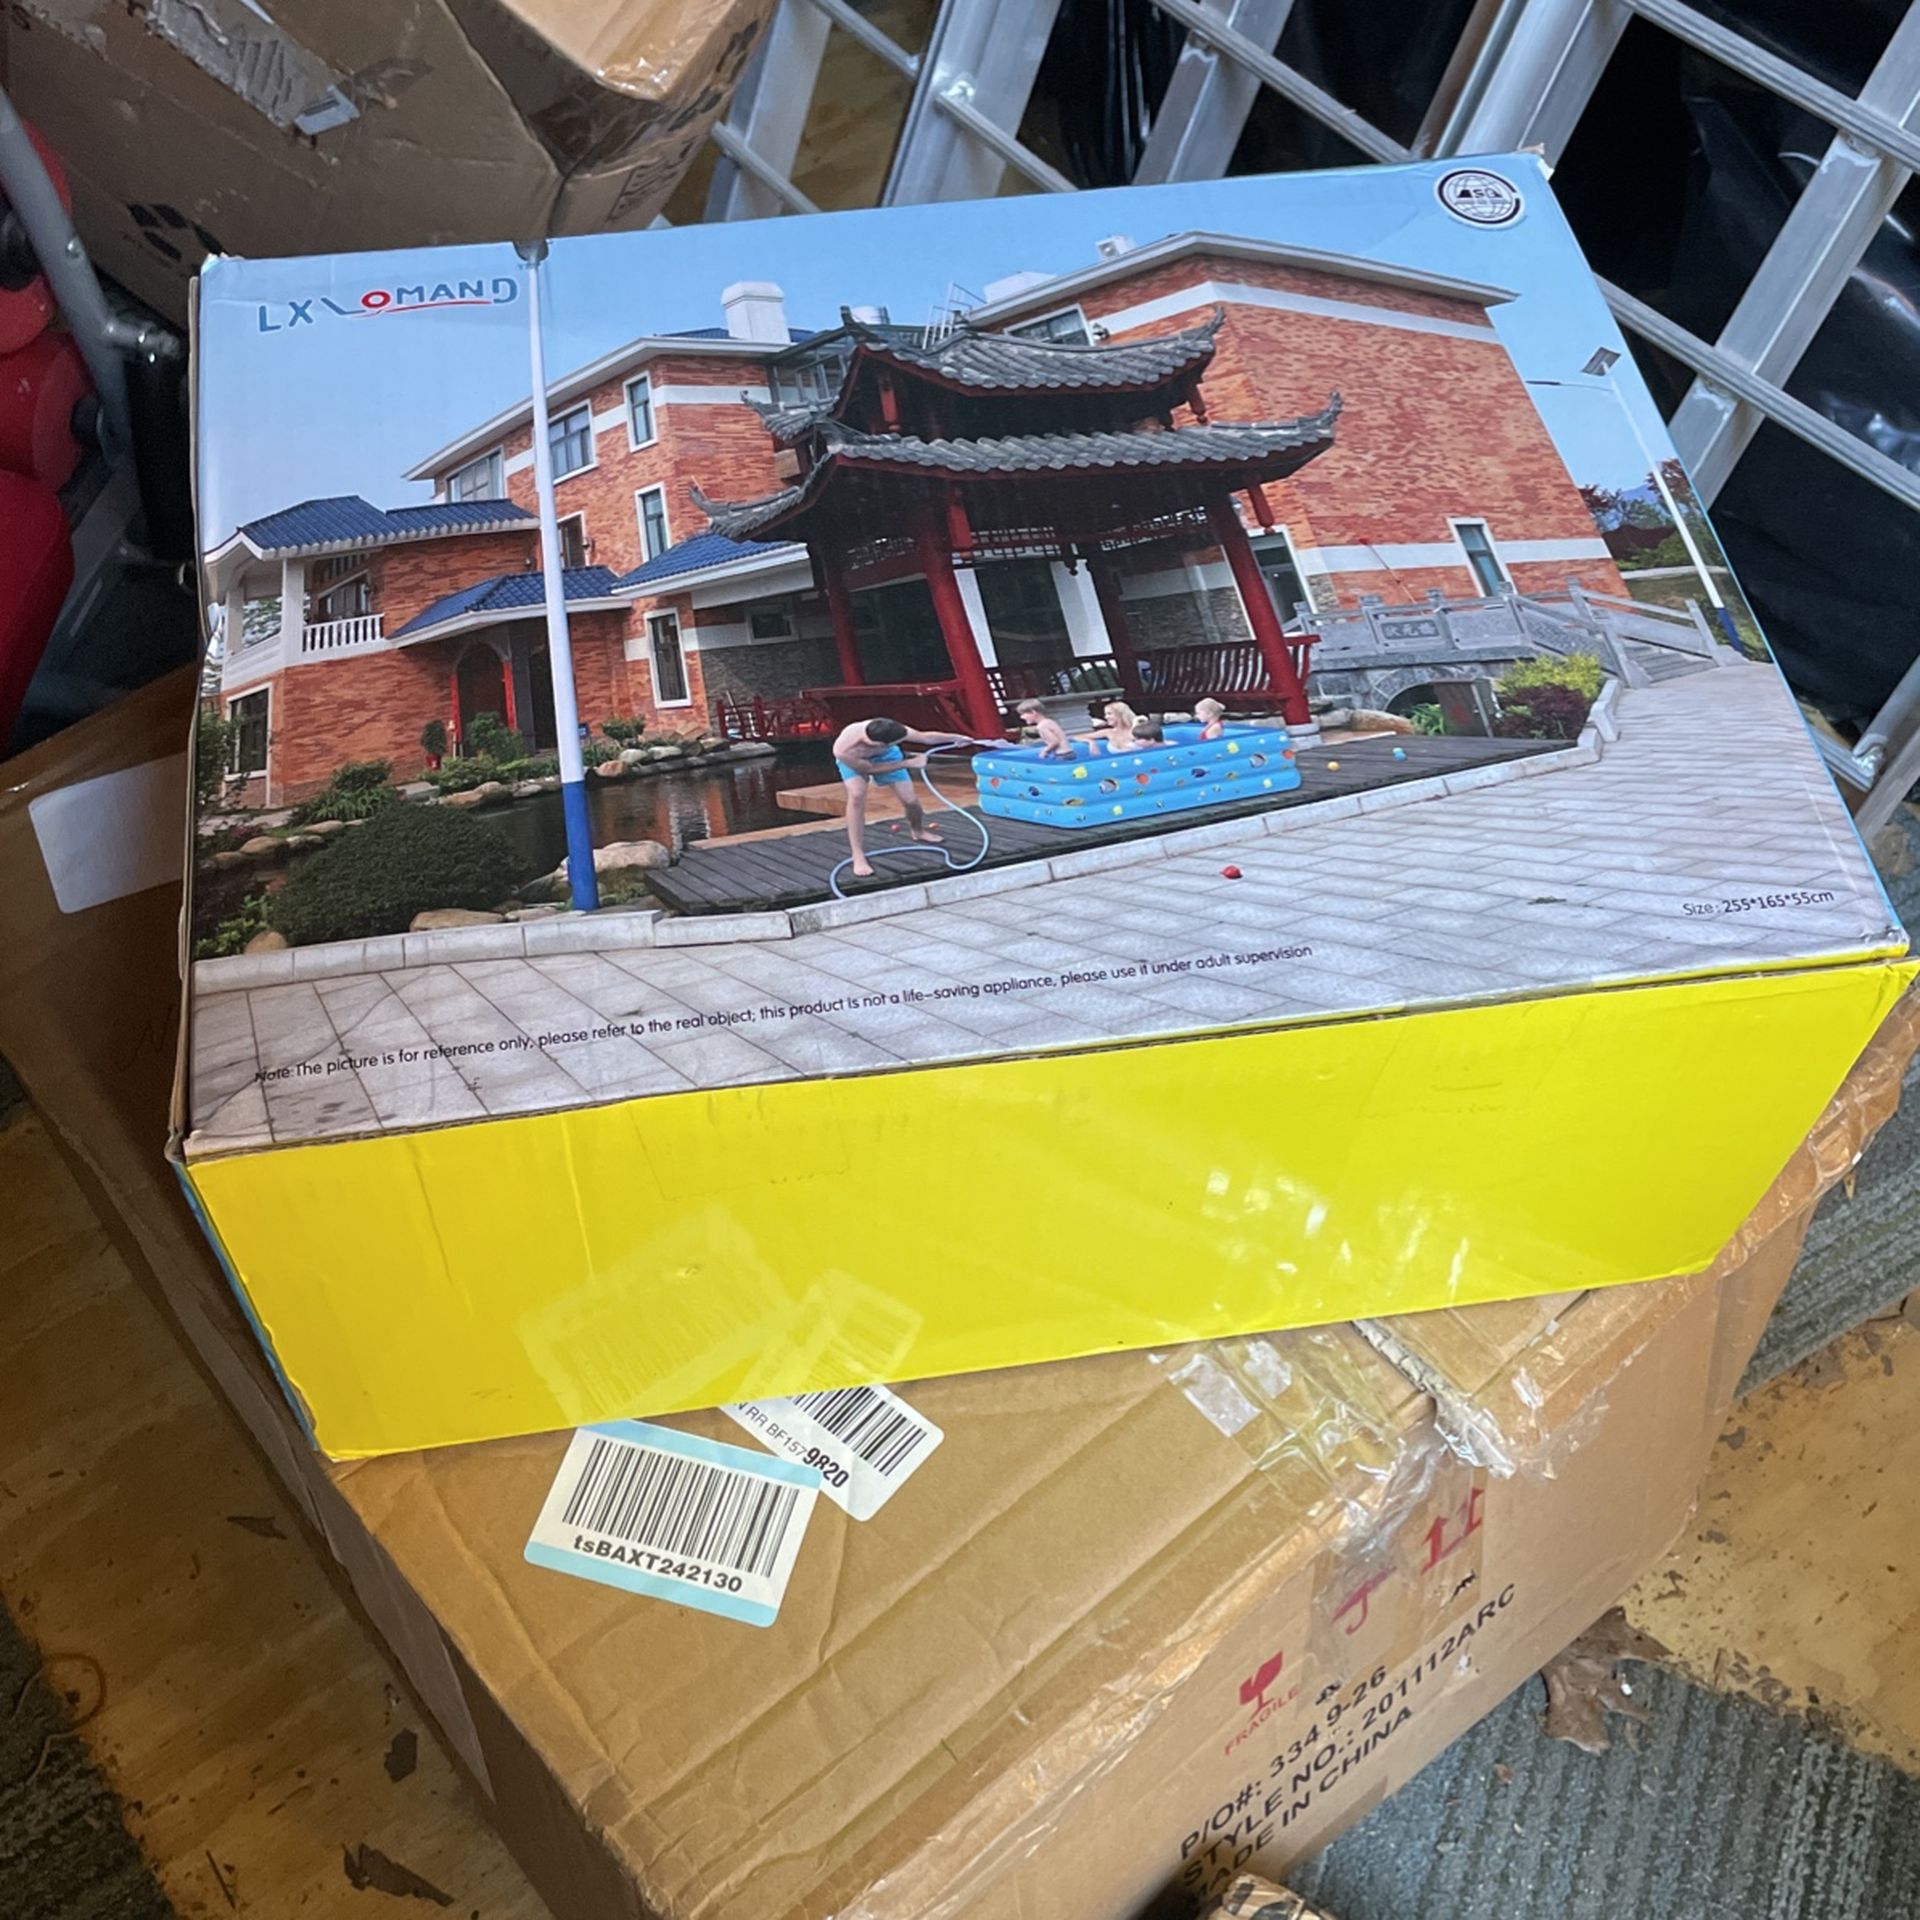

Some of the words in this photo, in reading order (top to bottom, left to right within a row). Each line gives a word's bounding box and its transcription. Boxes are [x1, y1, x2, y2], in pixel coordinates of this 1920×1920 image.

[327, 1055, 378, 1075] picture
[382, 1051, 395, 1064] is
[399, 1049, 419, 1063] for
[423, 1041, 495, 1060] reference
[499, 1035, 534, 1051] only,
[538, 1031, 589, 1049] please
[592, 1025, 628, 1039] refer
[630, 1023, 644, 1036] to
[649, 1020, 672, 1033] the
[676, 1014, 704, 1030] real
[760, 1005, 786, 1020] this
[790, 998, 844, 1018] product
[848, 996, 860, 1010] is
[863, 993, 887, 1008] not
[890, 993, 900, 1005] a
[983, 976, 1057, 995] appliance,
[1061, 967, 1108, 988] please
[1110, 967, 1137, 979] use
[1140, 962, 1149, 976] it
[1152, 959, 1191, 975] under
[1196, 954, 1231, 969] adult
[1234, 945, 1312, 966] supervision
[573, 1535, 743, 1593] tsBAXT242130
[1184, 1786, 1283, 1887] STYLE
[1362, 1583, 1515, 1732] 201112ARC
[1224, 1683, 1299, 1756] FRAGILE
[1282, 1790, 1311, 1827] IN
[1319, 1705, 1412, 1793] CHINA
[1181, 1780, 1262, 1860] P/O#:
